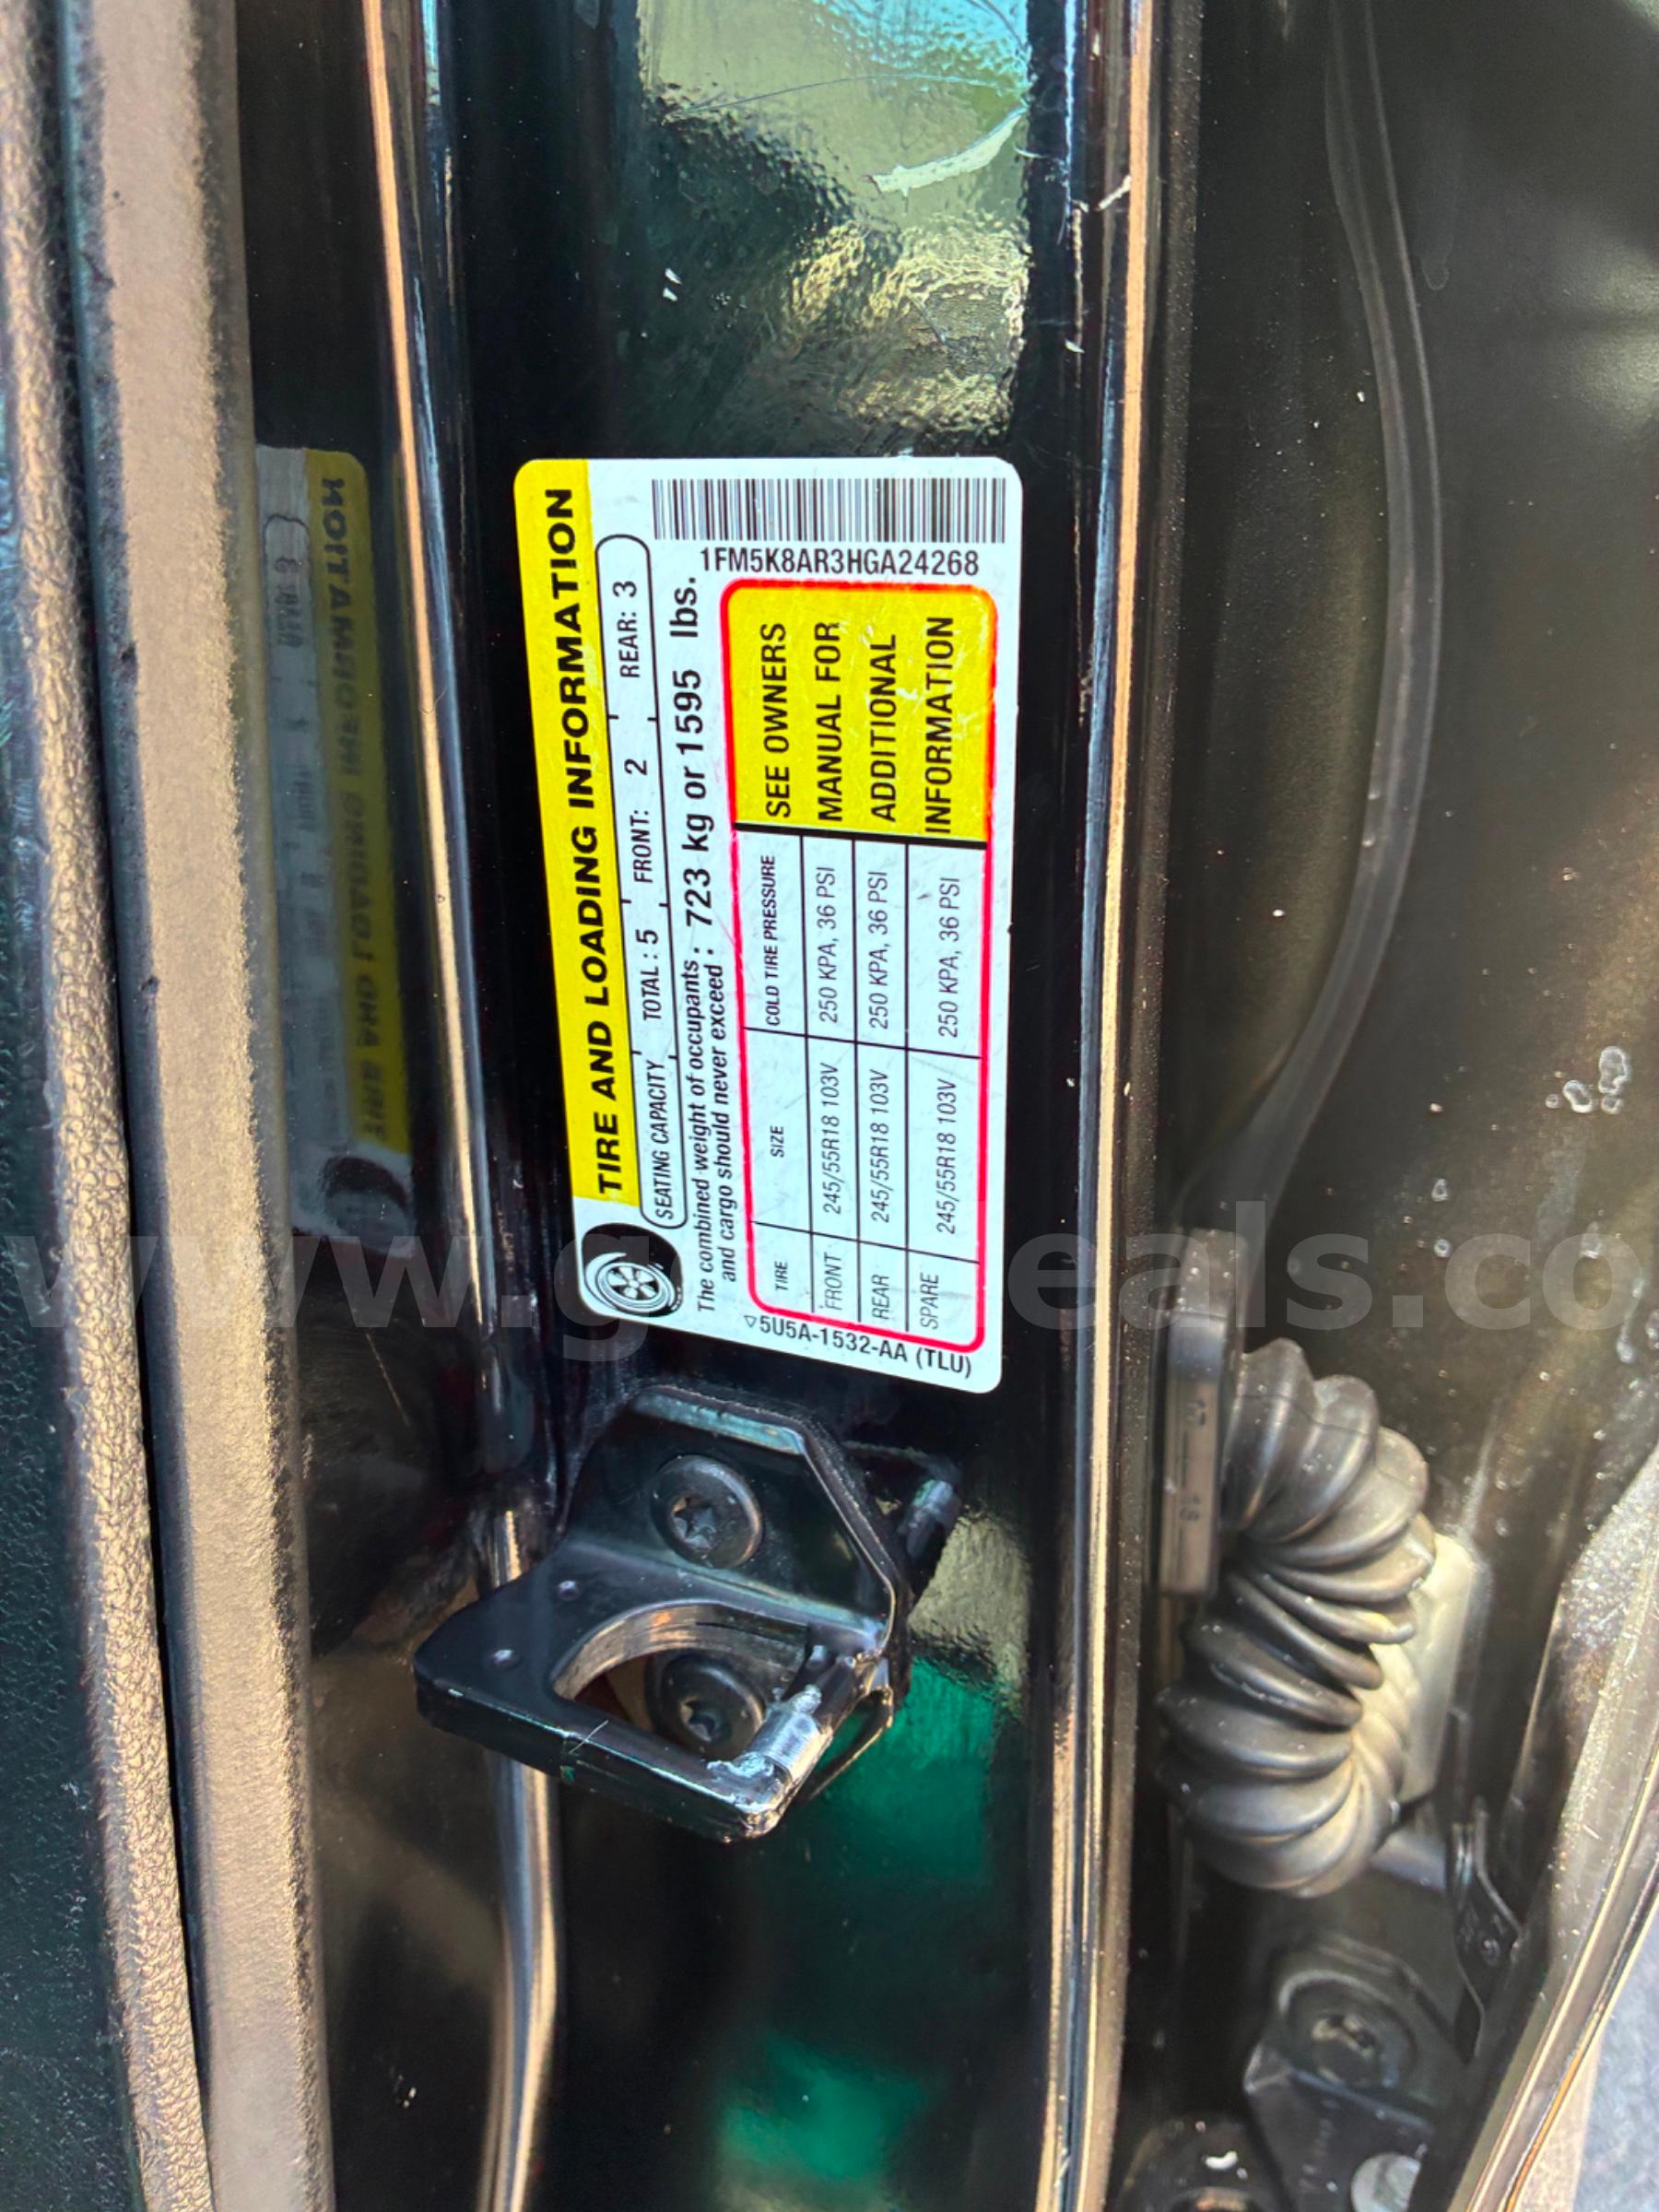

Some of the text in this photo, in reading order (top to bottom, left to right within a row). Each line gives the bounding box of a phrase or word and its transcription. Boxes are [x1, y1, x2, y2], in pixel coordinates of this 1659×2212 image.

[612, 581, 641, 678] REAR: 3
[669, 577, 699, 638] lbs.
[700, 547, 979, 576] 1FM5K8AR3HGA24268
[672, 669, 704, 756] 1595
[759, 623, 791, 818] SEE OWNERS
[814, 622, 842, 822] MANUAL FOR
[869, 634, 897, 822] ADDITIONAL
[924, 618, 954, 834] INFORMATION
[545, 488, 622, 1194] TIRE AND LOADING INFORMATION
[623, 759, 653, 884] FRONT: 2
[680, 813, 715, 852] kg
[682, 765, 706, 800] or
[634, 929, 659, 946] 5
[682, 867, 713, 927] 723
[759, 855, 781, 1027] COLD TIRE PRESSURE
[815, 866, 839, 1023] 250 KPA, 36 PSI
[867, 872, 890, 1030] 250 KPA, 36 PSI
[937, 877, 962, 1038] 250 KPA, 36 PSI
[645, 1059, 675, 1220] SEATING CAPACITY
[680, 959, 715, 1312] The combined weight of occupants
[702, 964, 737, 1283] and cargo should never exceed
[770, 1125, 785, 1158] SIZE
[819, 1062, 846, 1215] 245/55R18 103V
[869, 1069, 894, 1224] 245/55R18 103V
[935, 1078, 960, 1235] 245/55R18 103V
[774, 1261, 789, 1290] TIRE
[819, 1252, 842, 1311] FRONT
[871, 1274, 890, 1320] REAR
[920, 1272, 939, 1330] SPARE
[915, 1346, 972, 1380] (TLU)
